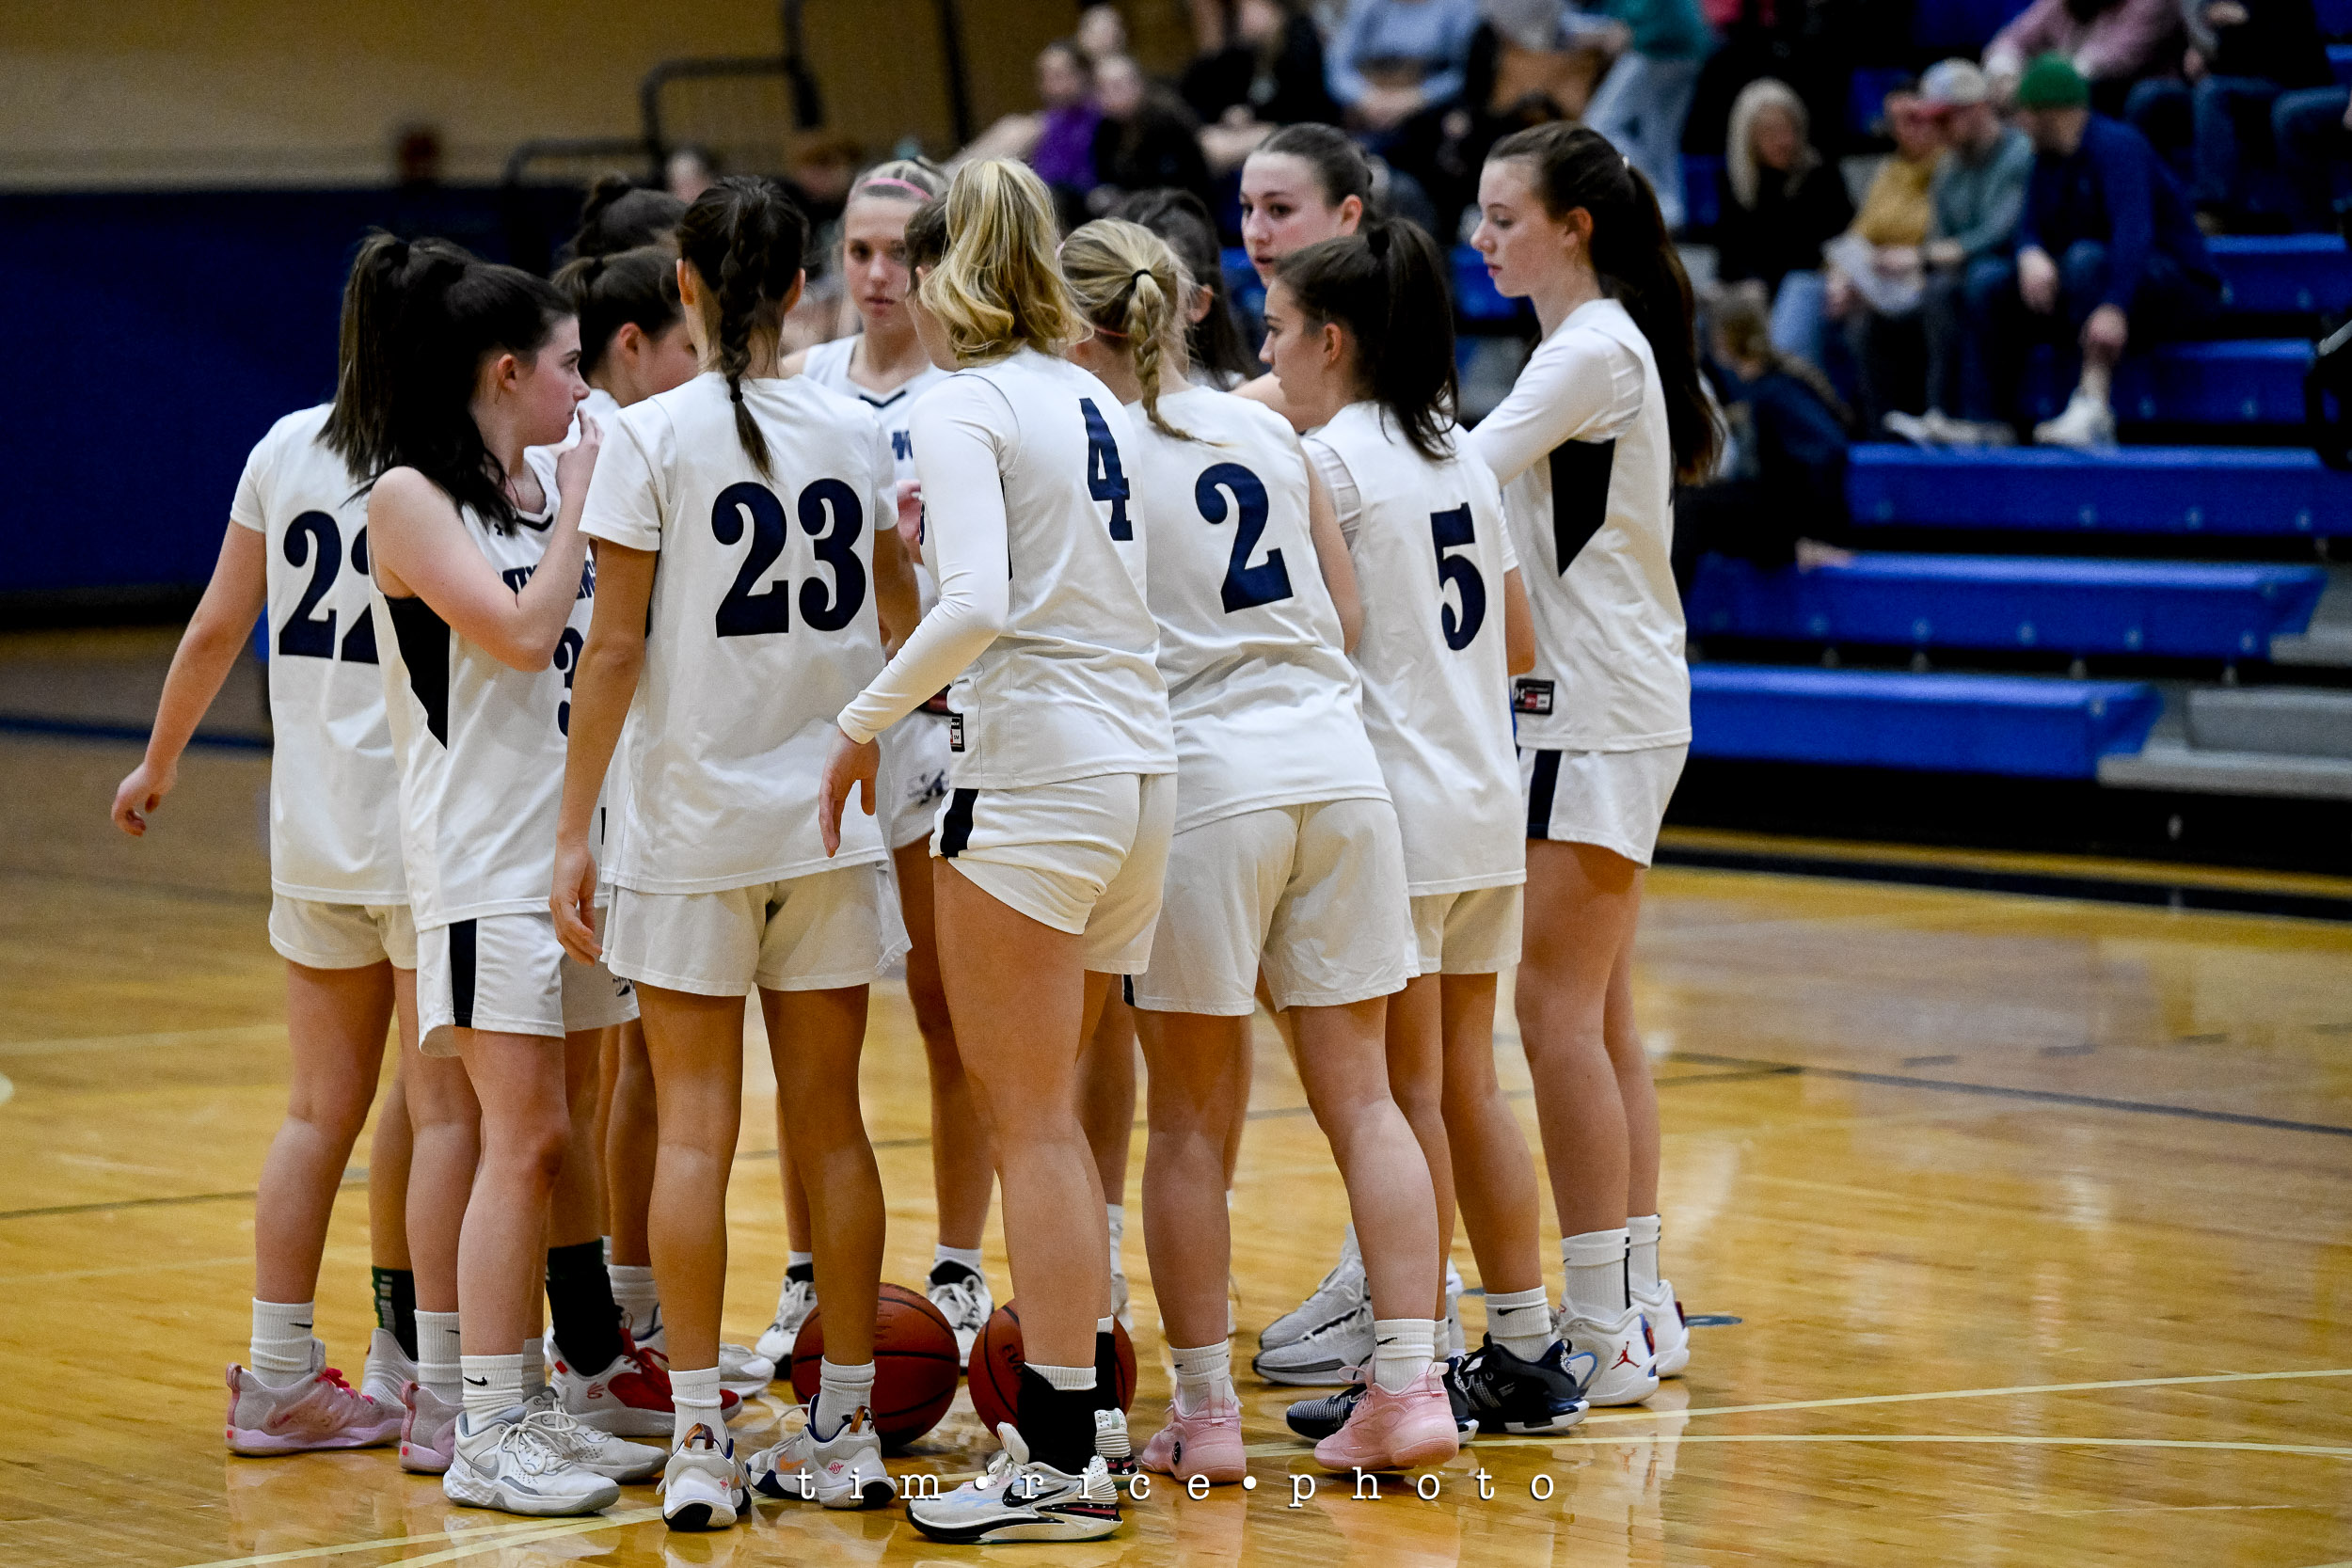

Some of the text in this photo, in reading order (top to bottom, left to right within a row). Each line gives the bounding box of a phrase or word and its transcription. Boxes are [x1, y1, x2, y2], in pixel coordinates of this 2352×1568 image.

[1079, 397, 1134, 542] 4
[1195, 462, 1295, 614] 2
[711, 478, 866, 639] 23
[1430, 501, 1486, 651] 5
